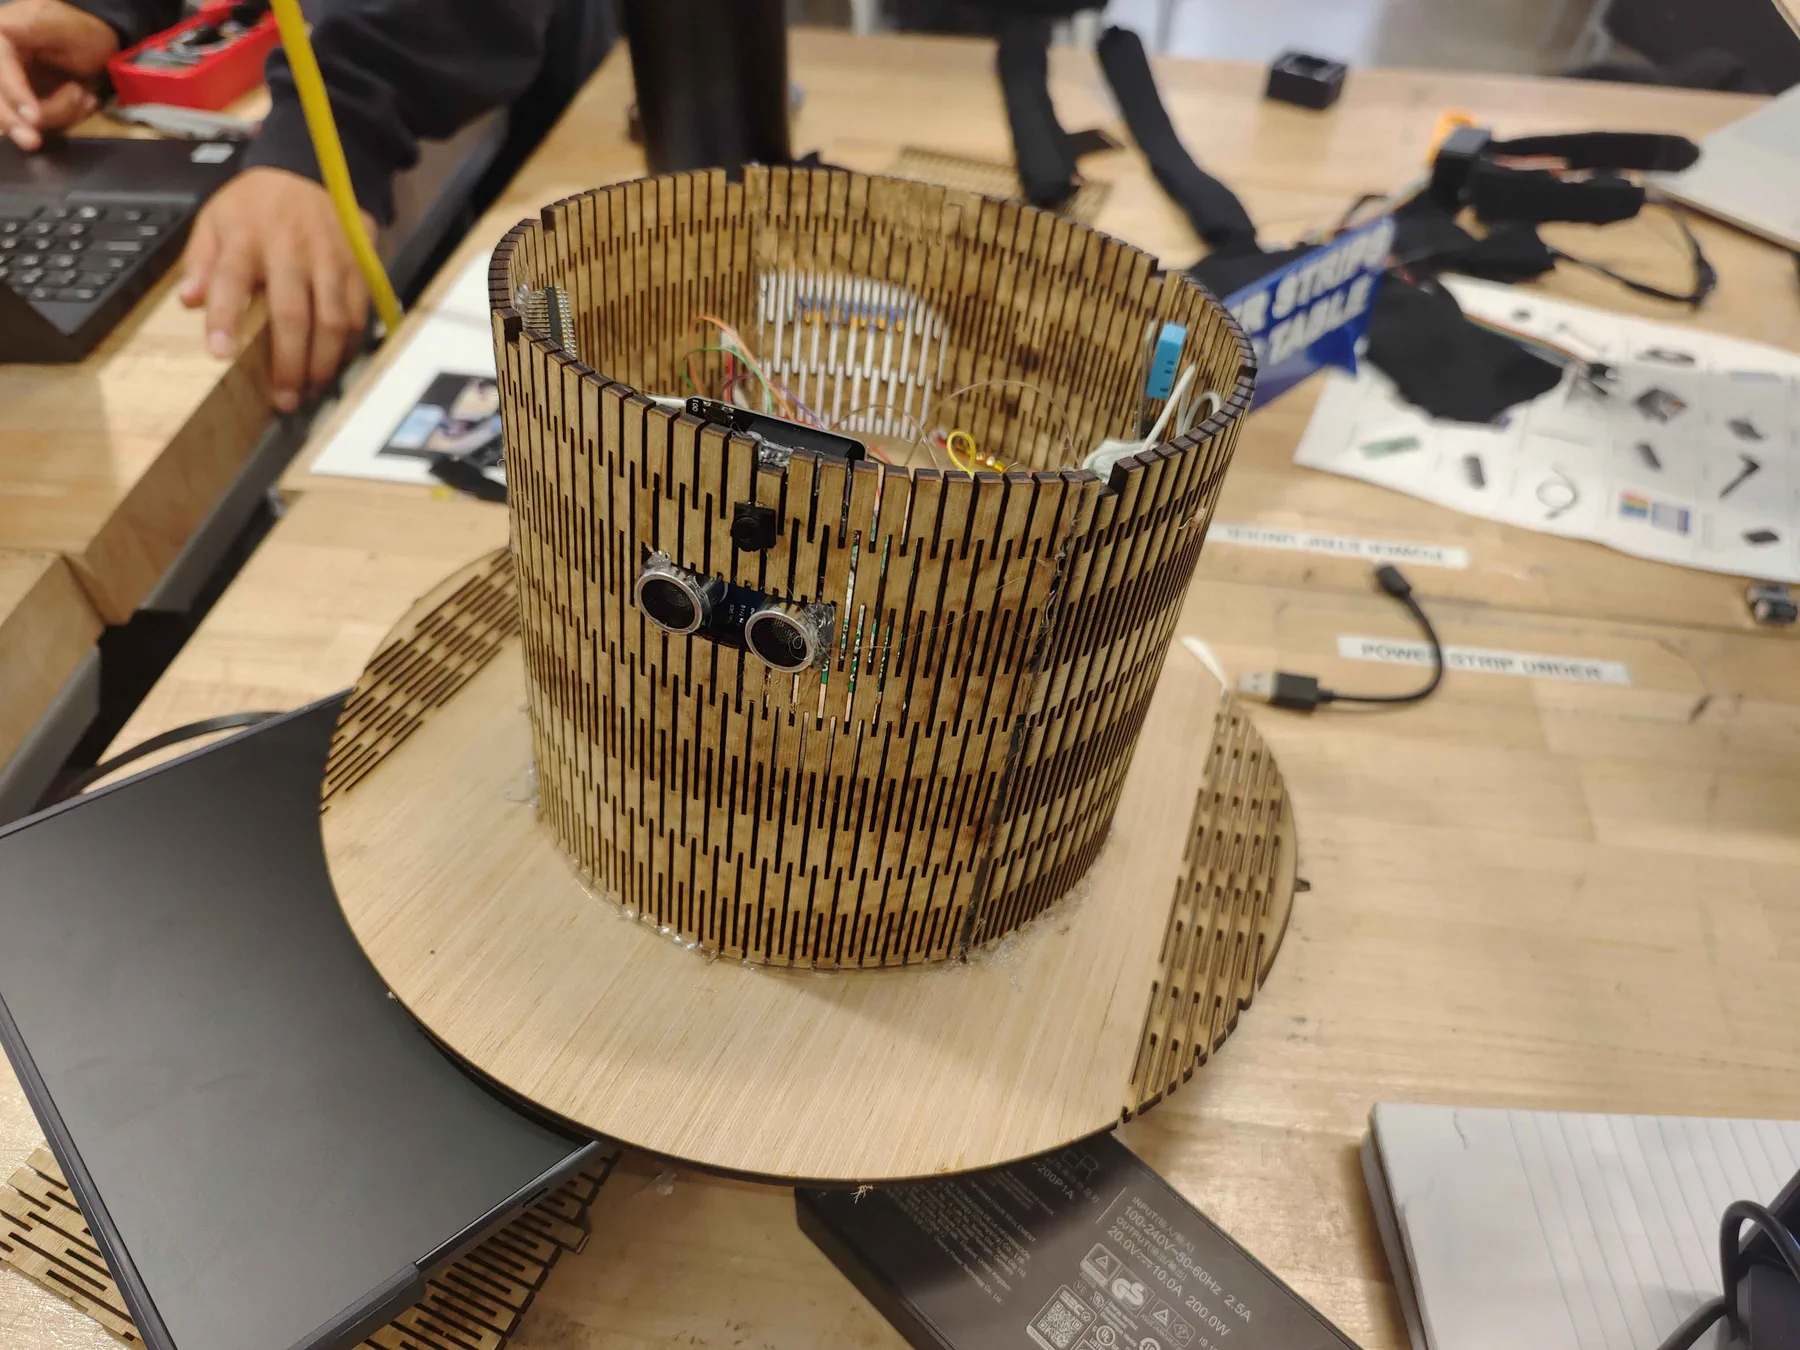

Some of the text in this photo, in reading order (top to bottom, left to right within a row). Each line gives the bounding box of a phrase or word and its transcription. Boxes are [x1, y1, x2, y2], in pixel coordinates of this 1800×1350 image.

[1360, 642, 1438, 665] POWE
[1451, 653, 1517, 673] STRIP
[1185, 1296, 1229, 1335] 200.0W
[1224, 1294, 1252, 1320] 2.5A
